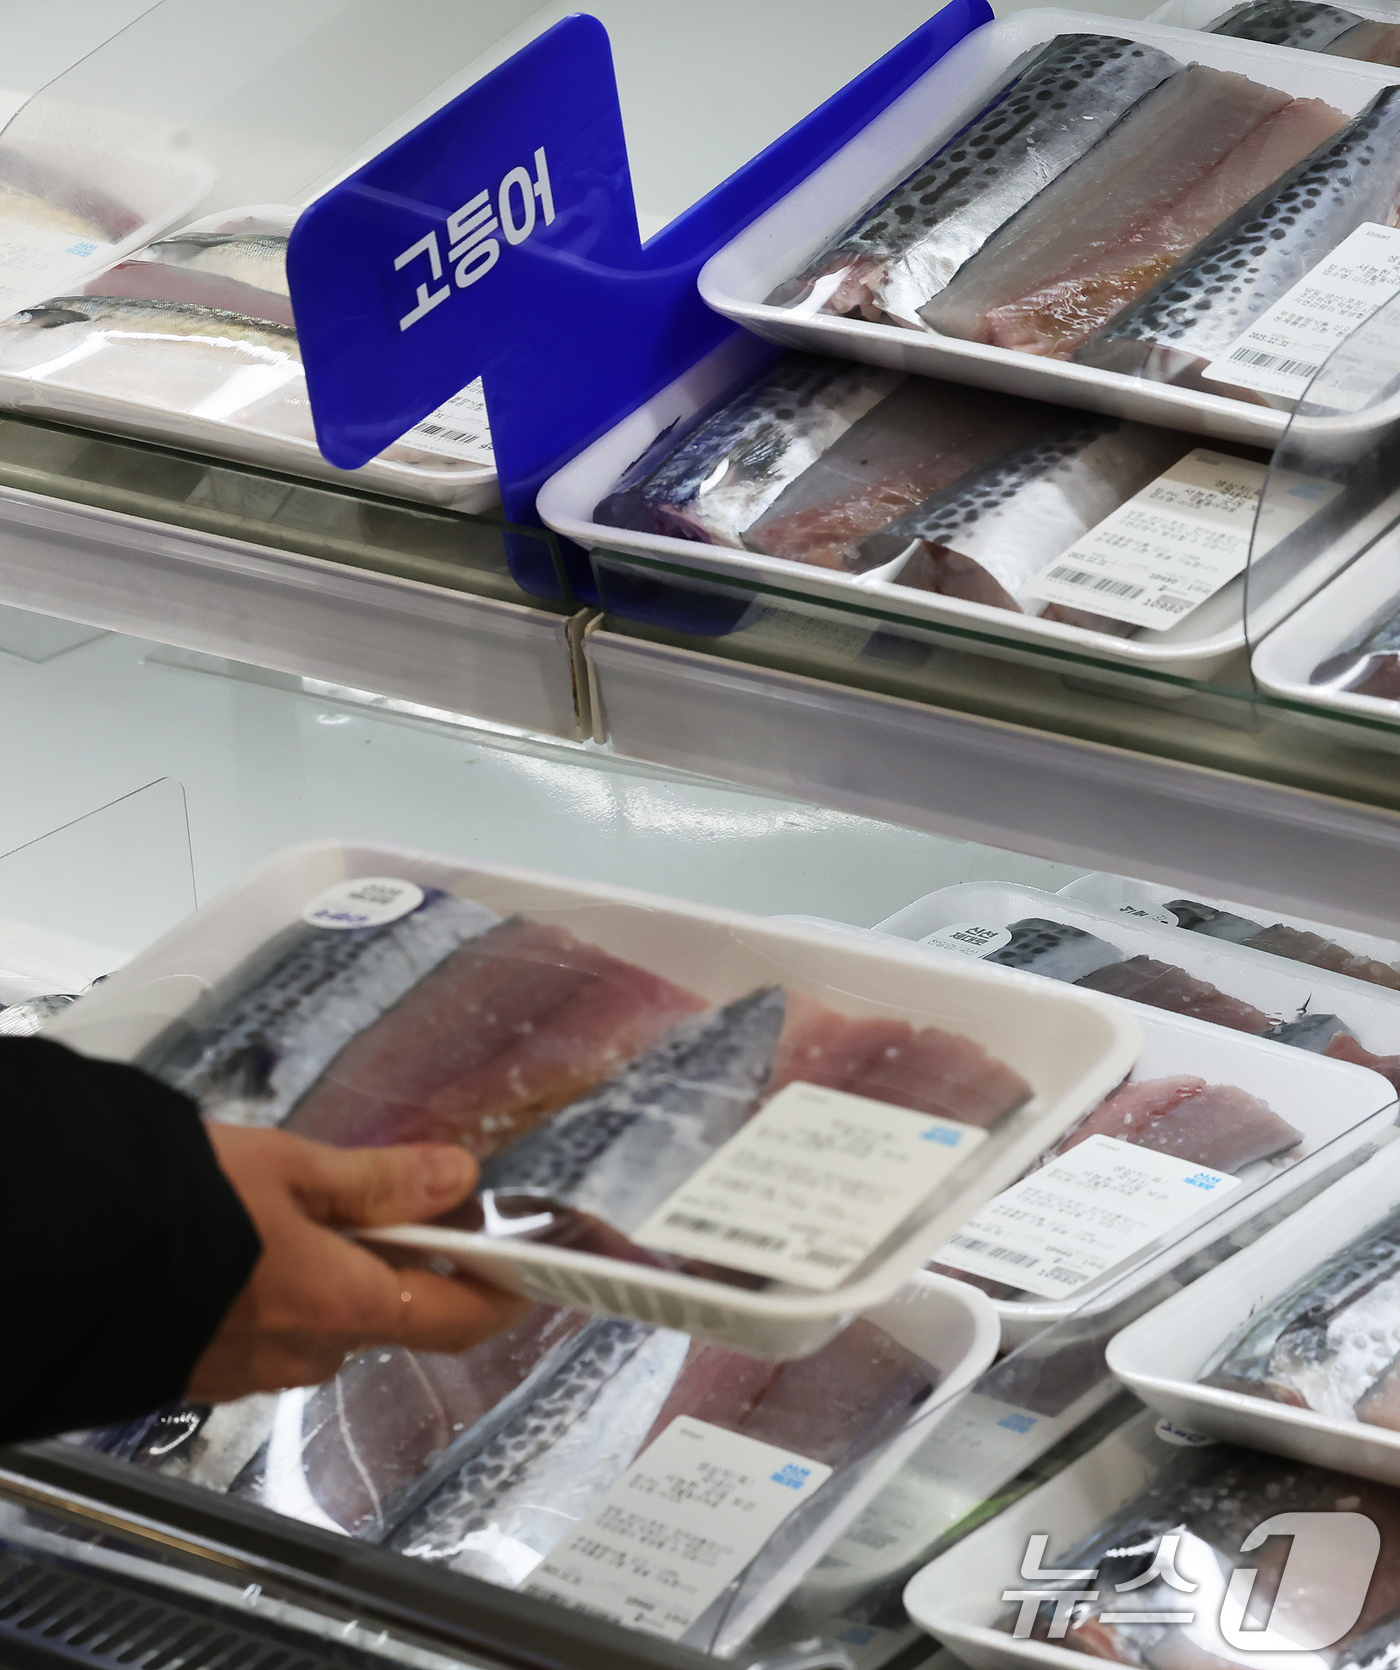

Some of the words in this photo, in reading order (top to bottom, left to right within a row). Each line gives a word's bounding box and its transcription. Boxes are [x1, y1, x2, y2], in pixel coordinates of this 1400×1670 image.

[394, 146, 556, 332] 고등어
[949, 932, 988, 946] 제대로
[965, 926, 999, 940] 신선
